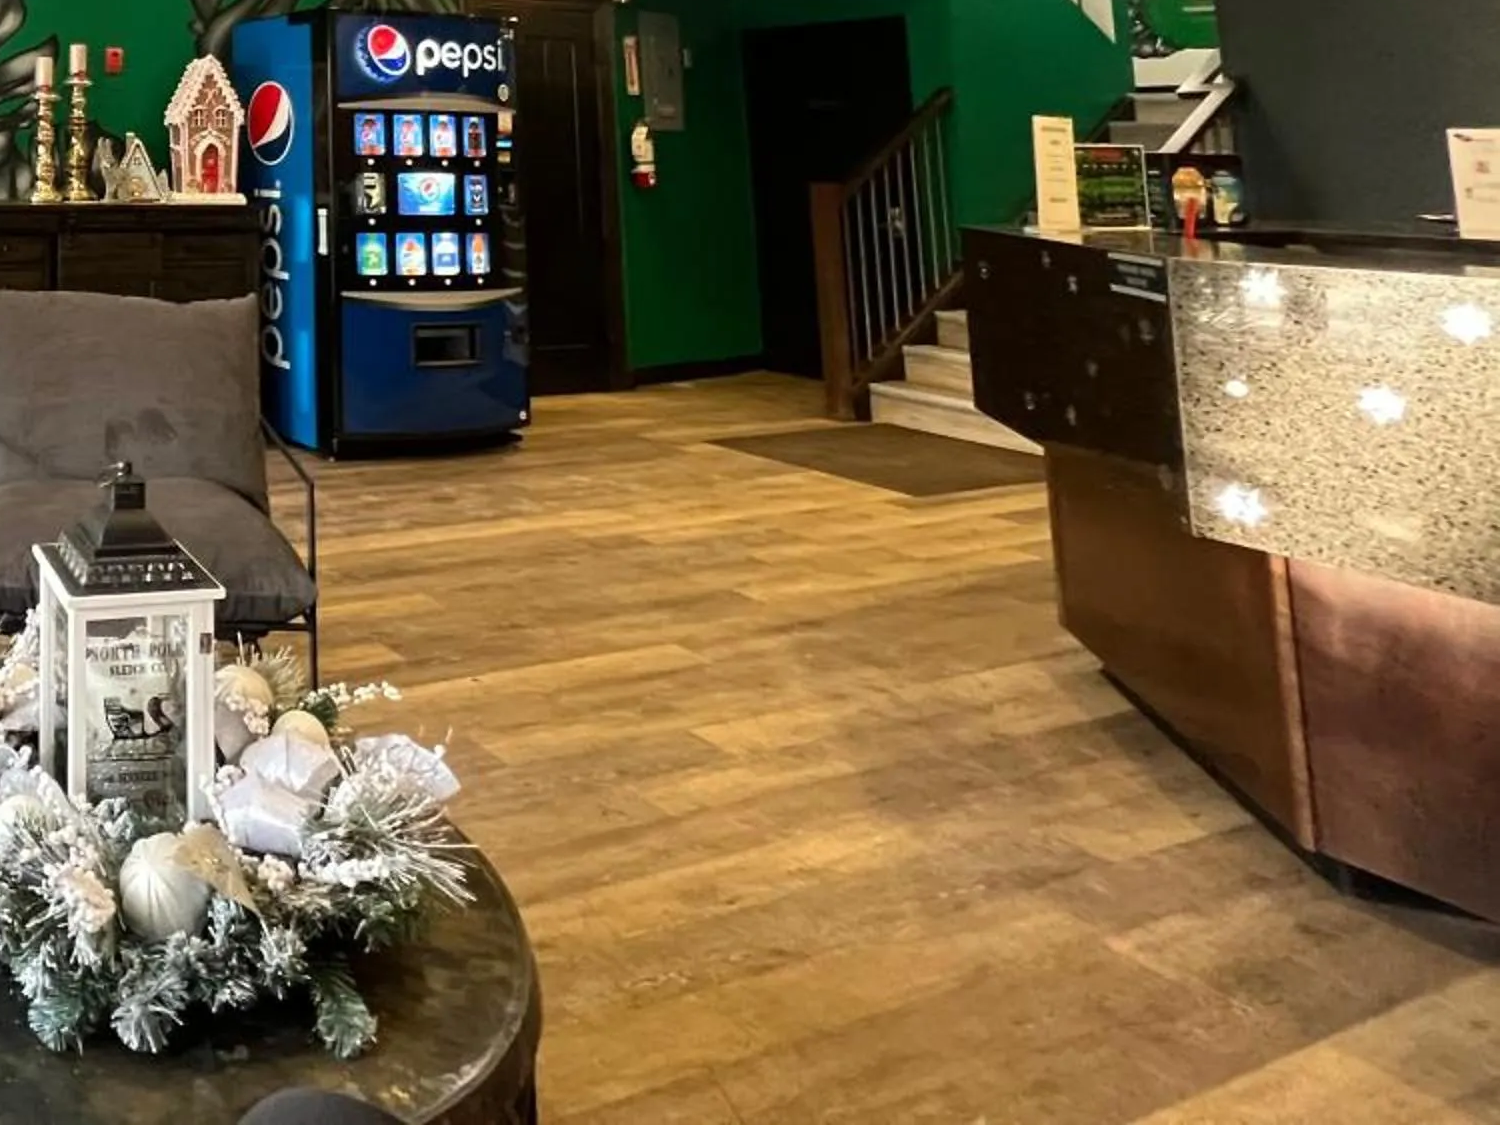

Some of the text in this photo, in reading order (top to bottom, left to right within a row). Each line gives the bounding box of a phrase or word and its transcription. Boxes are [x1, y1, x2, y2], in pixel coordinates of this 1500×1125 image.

[415, 38, 502, 78] pepsi
[254, 187, 291, 370] pepsi
[86, 643, 141, 663] NORTH
